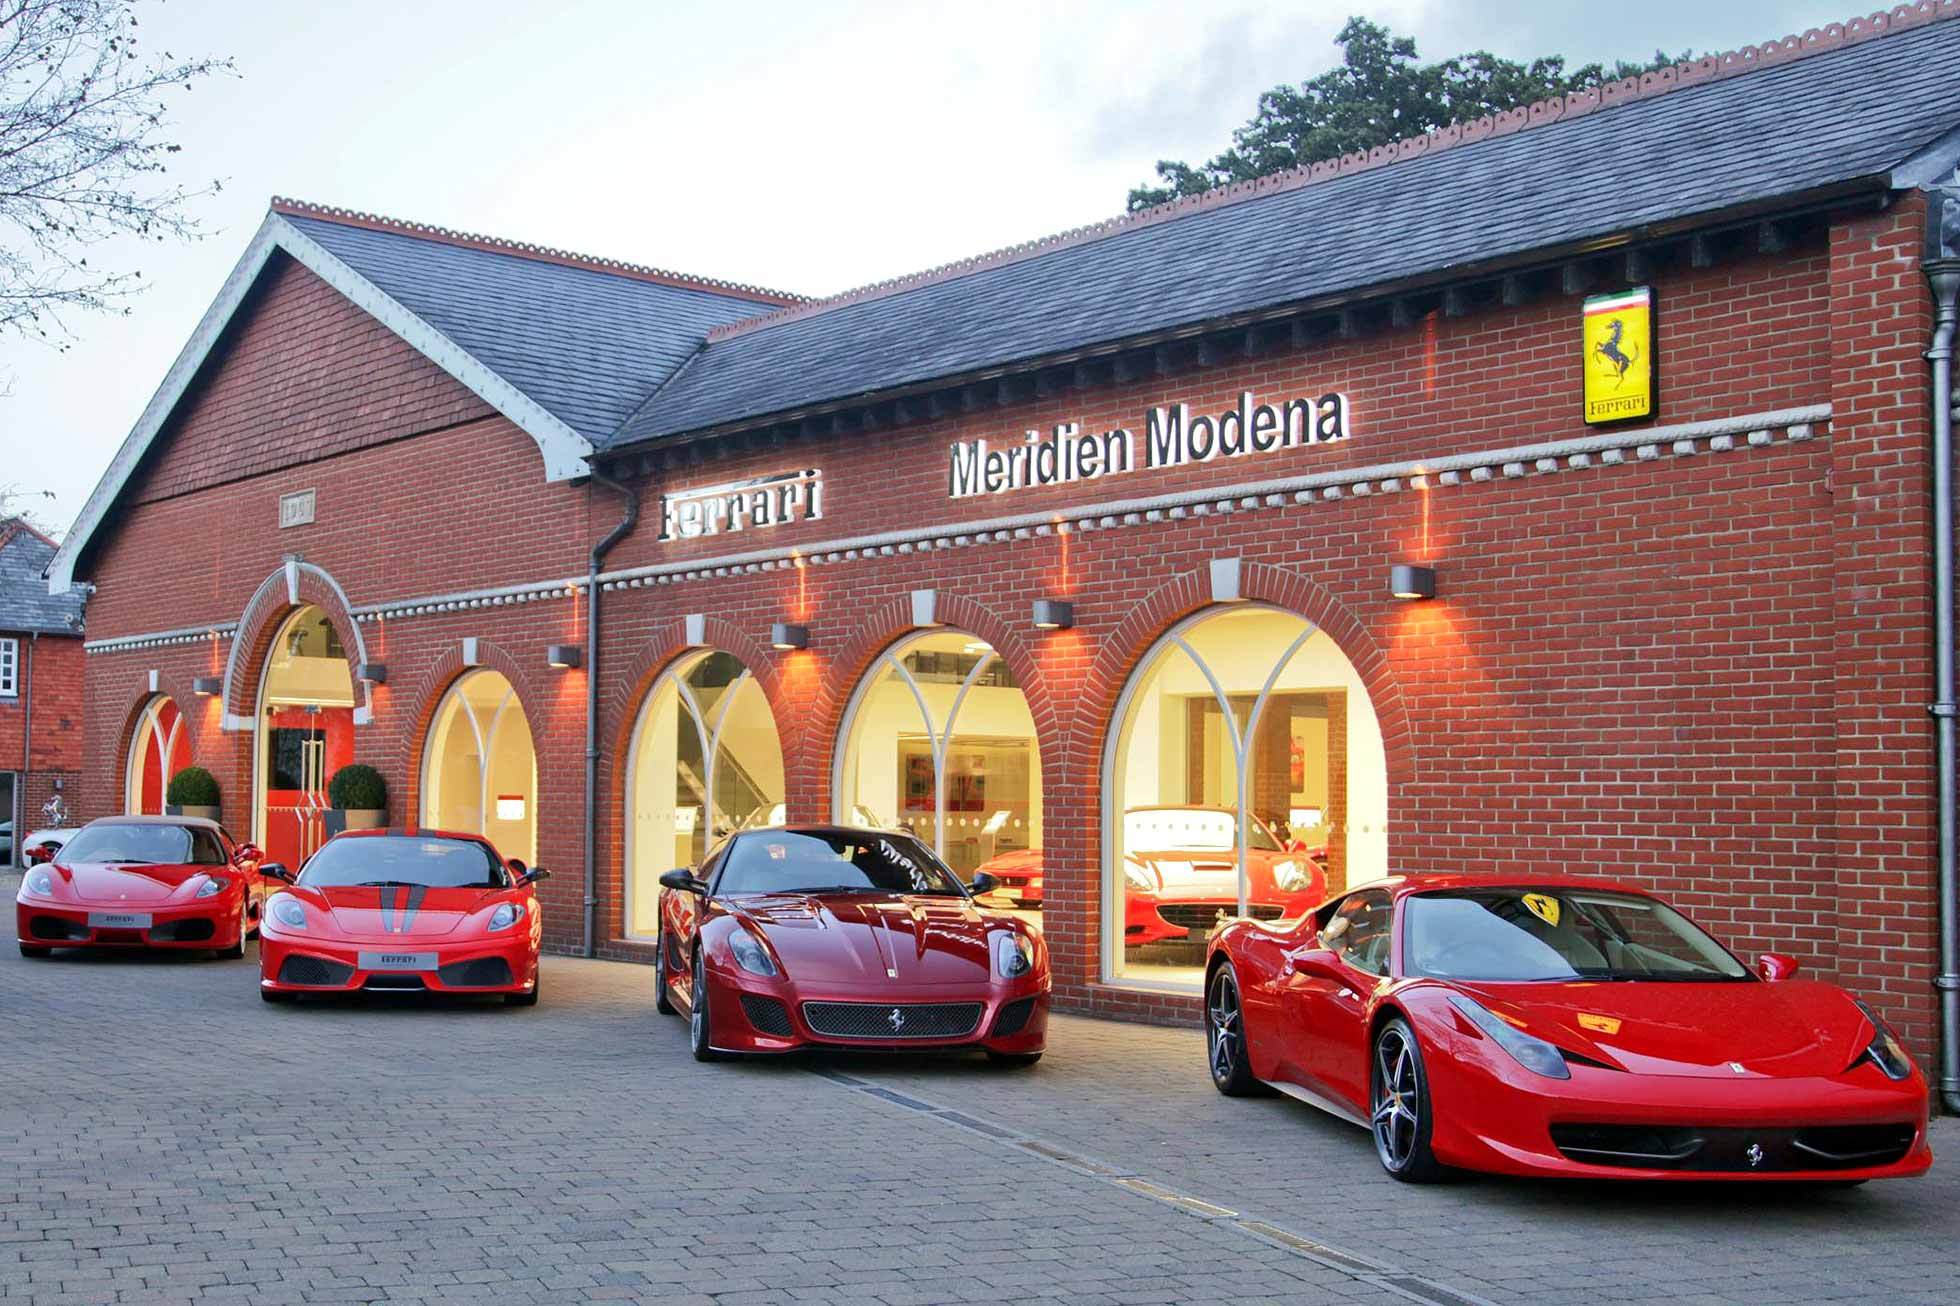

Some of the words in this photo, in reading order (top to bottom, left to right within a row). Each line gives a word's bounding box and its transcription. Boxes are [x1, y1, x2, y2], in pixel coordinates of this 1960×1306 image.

[1590, 394, 1646, 416] Ferrari
[949, 423, 1134, 498] Meridien
[1146, 392, 1350, 469] Modena
[658, 469, 824, 542] Ferrari
